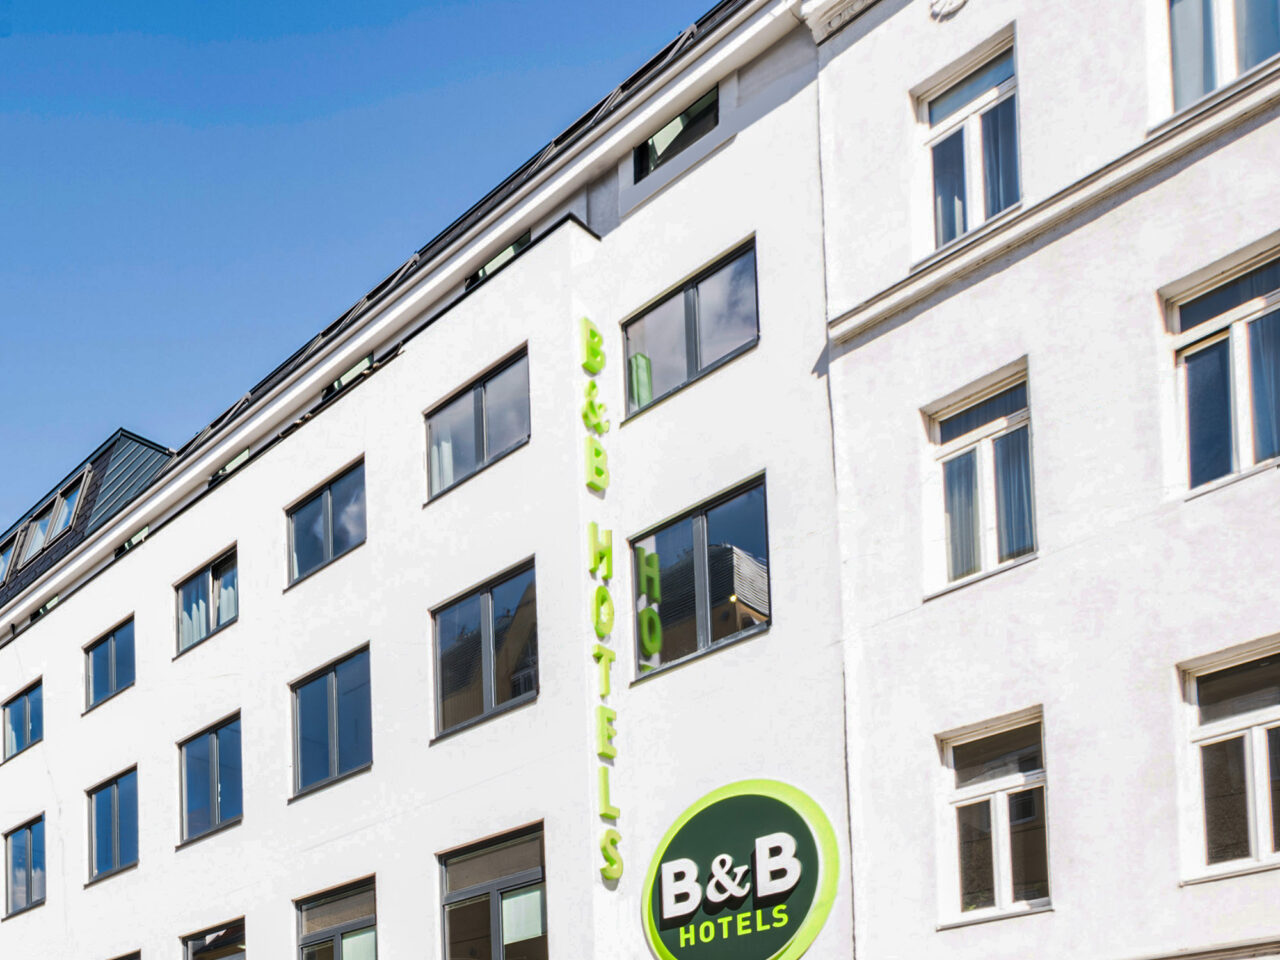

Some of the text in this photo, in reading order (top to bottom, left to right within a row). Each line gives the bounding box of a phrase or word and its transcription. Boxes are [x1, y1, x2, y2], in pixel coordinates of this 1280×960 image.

[580, 316, 624, 882] B&B HOTELS
[660, 831, 802, 921] B&B
[679, 904, 789, 948] HOTELS
